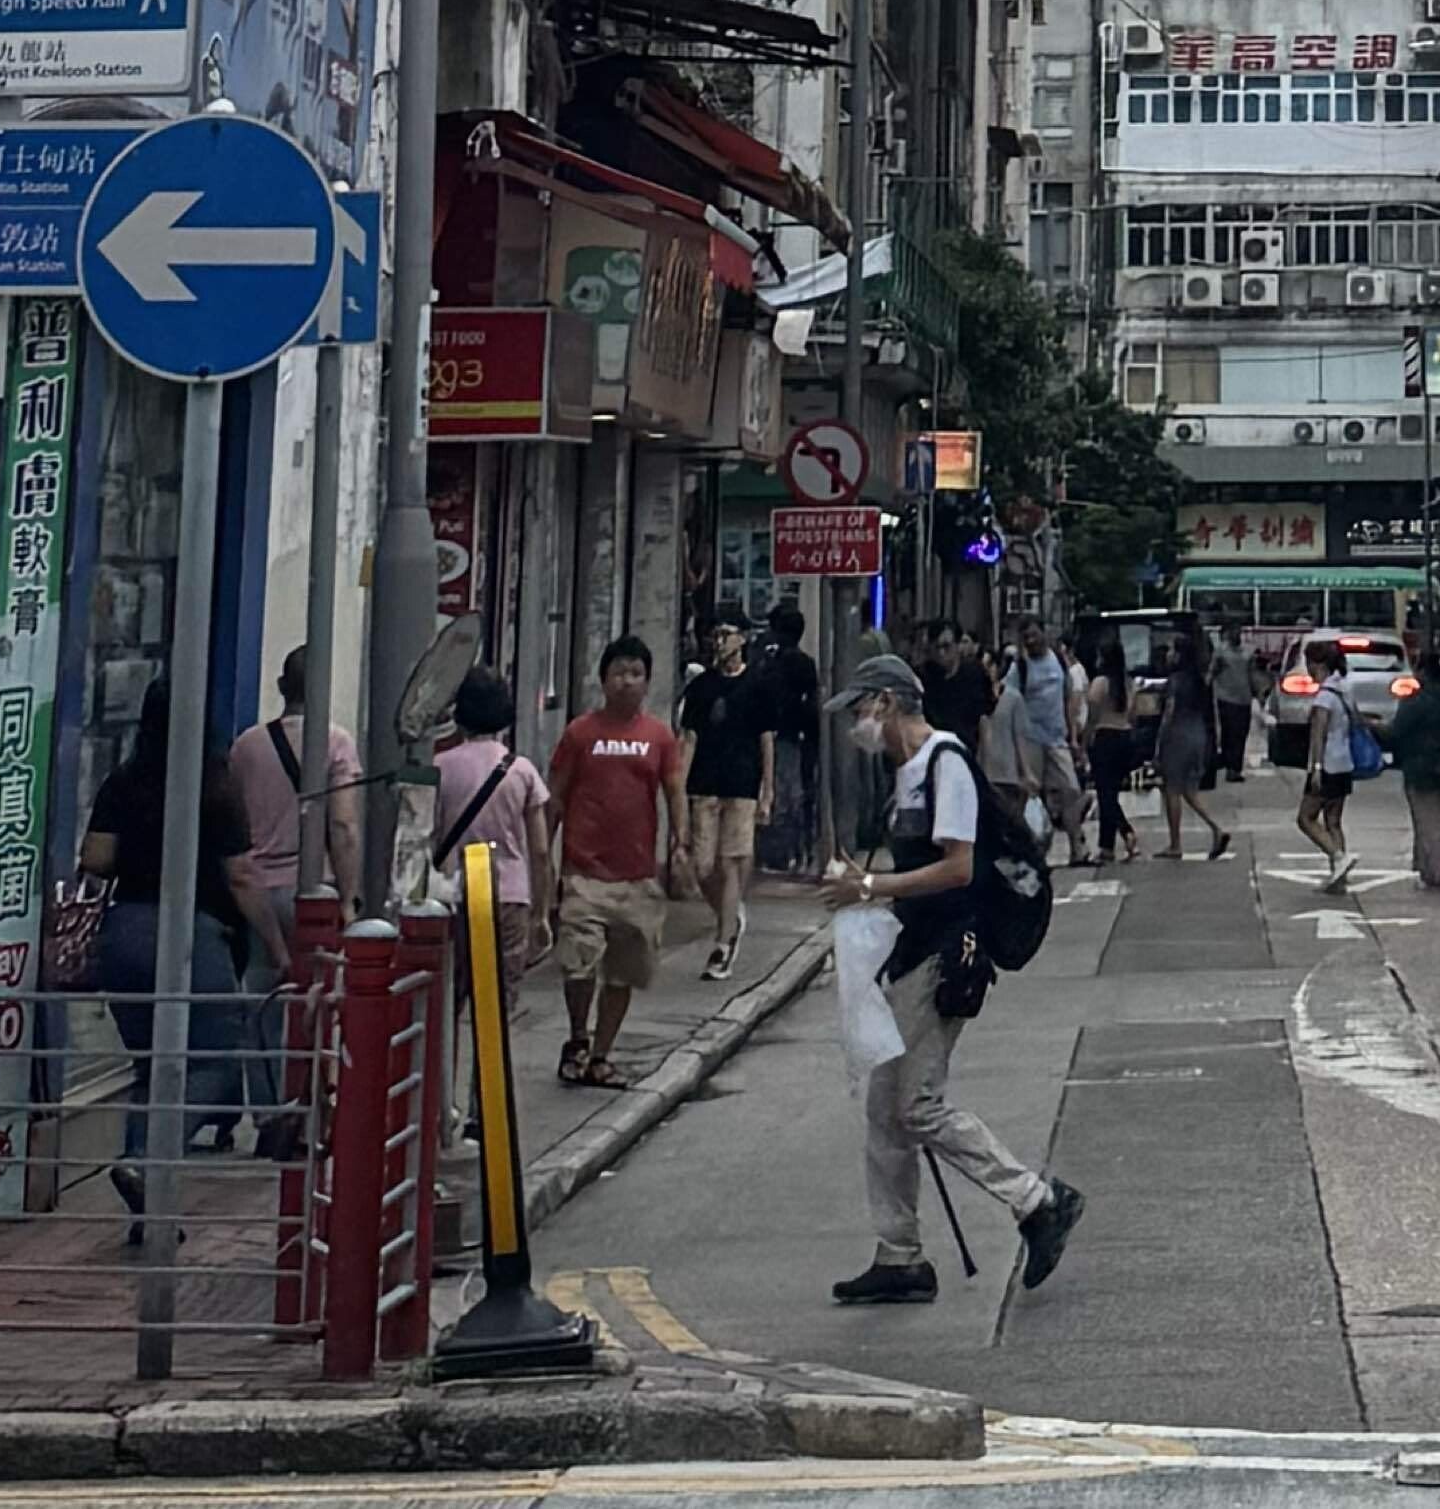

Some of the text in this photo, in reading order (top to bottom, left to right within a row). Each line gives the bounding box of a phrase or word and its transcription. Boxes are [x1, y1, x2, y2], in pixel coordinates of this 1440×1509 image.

[33, 64, 92, 79] Kowloon
[94, 62, 143, 77] Station
[21, 180, 71, 195] Station
[17, 258, 67, 274] Station
[783, 512, 866, 529] BEWARE OF
[776, 527, 875, 544] PEDESTRIANS
[790, 547, 862, 572] 小心行人
[591, 739, 651, 757] ARMY
